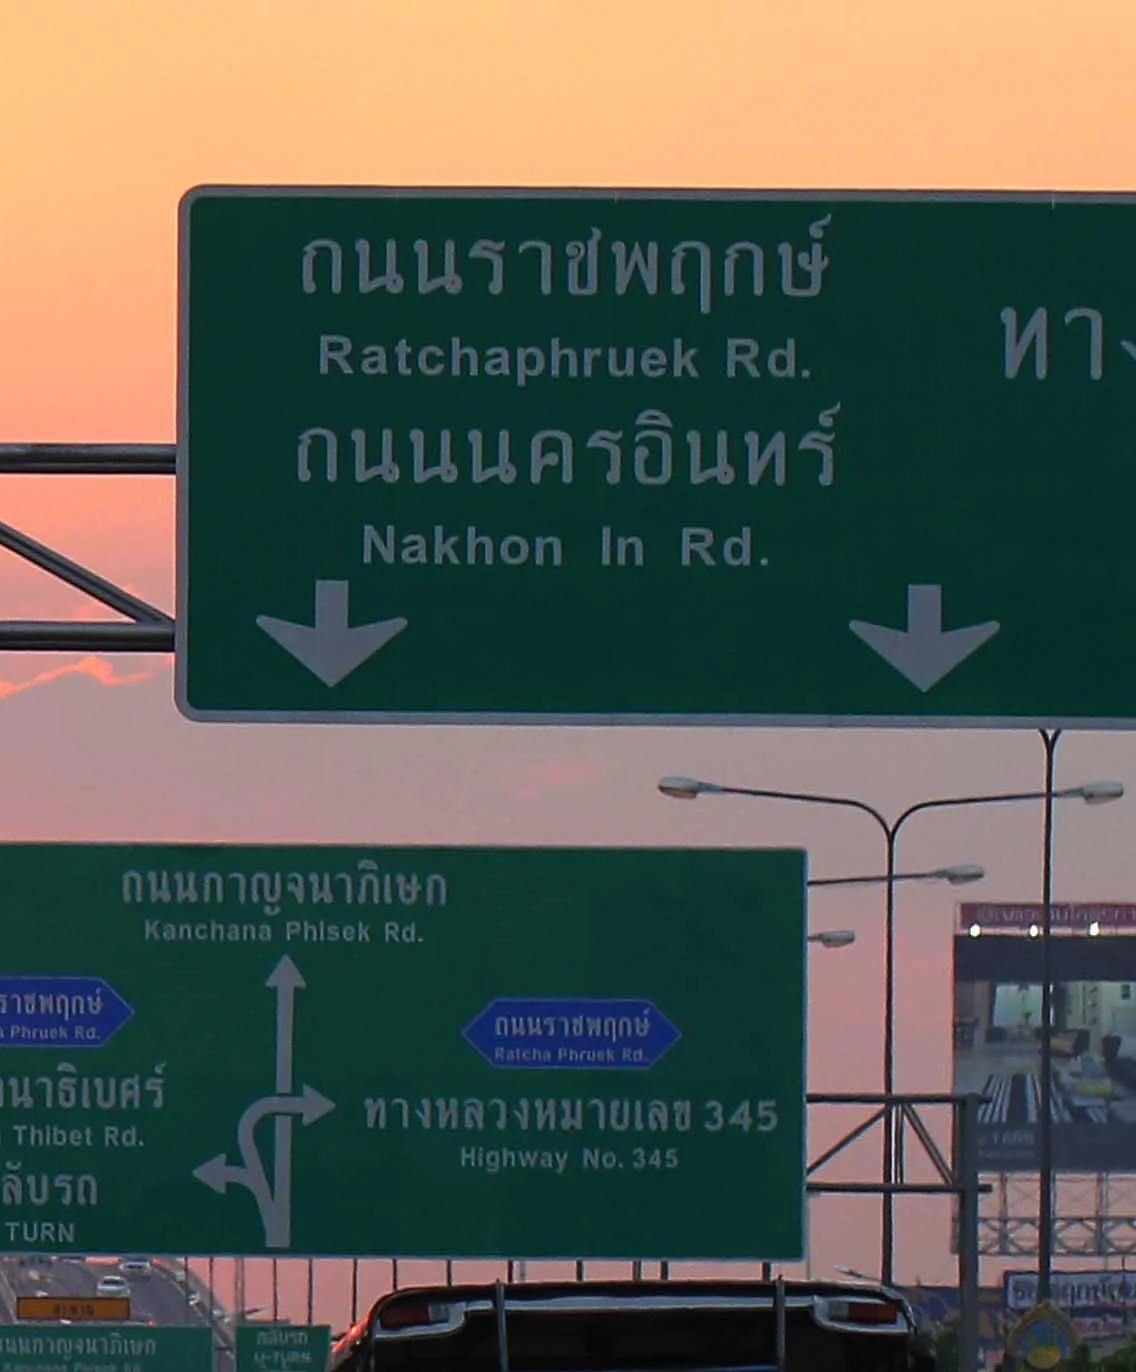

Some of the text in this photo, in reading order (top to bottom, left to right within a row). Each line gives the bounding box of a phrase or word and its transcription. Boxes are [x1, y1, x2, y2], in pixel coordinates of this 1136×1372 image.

[303, 214, 831, 314] ถนนราชพฤกษ์
[320, 335, 810, 386] Ratchaphruek Rd.
[1001, 307, 1136, 380] ทา
[298, 402, 840, 486] ถนนนครอินทร์
[364, 525, 768, 566] Nakhon In Rd.
[123, 860, 446, 915] ถนนกาญจนาภิเษก
[144, 919, 424, 943] Kanchana Phisek Rd.
[10, 1024, 68, 1039] Phruek
[74, 1024, 100, 1039] Rd.
[496, 1008, 649, 1043] ถนนราชพฤกษ์
[495, 1047, 647, 1062] Ratcha Phruek Rd.
[364, 1098, 777, 1131] ทางหลวงหมายเลข 345
[13, 1125, 92, 1146] Thibet
[105, 1126, 143, 1146] Rd.
[461, 1147, 677, 1173] Highway No. 345
